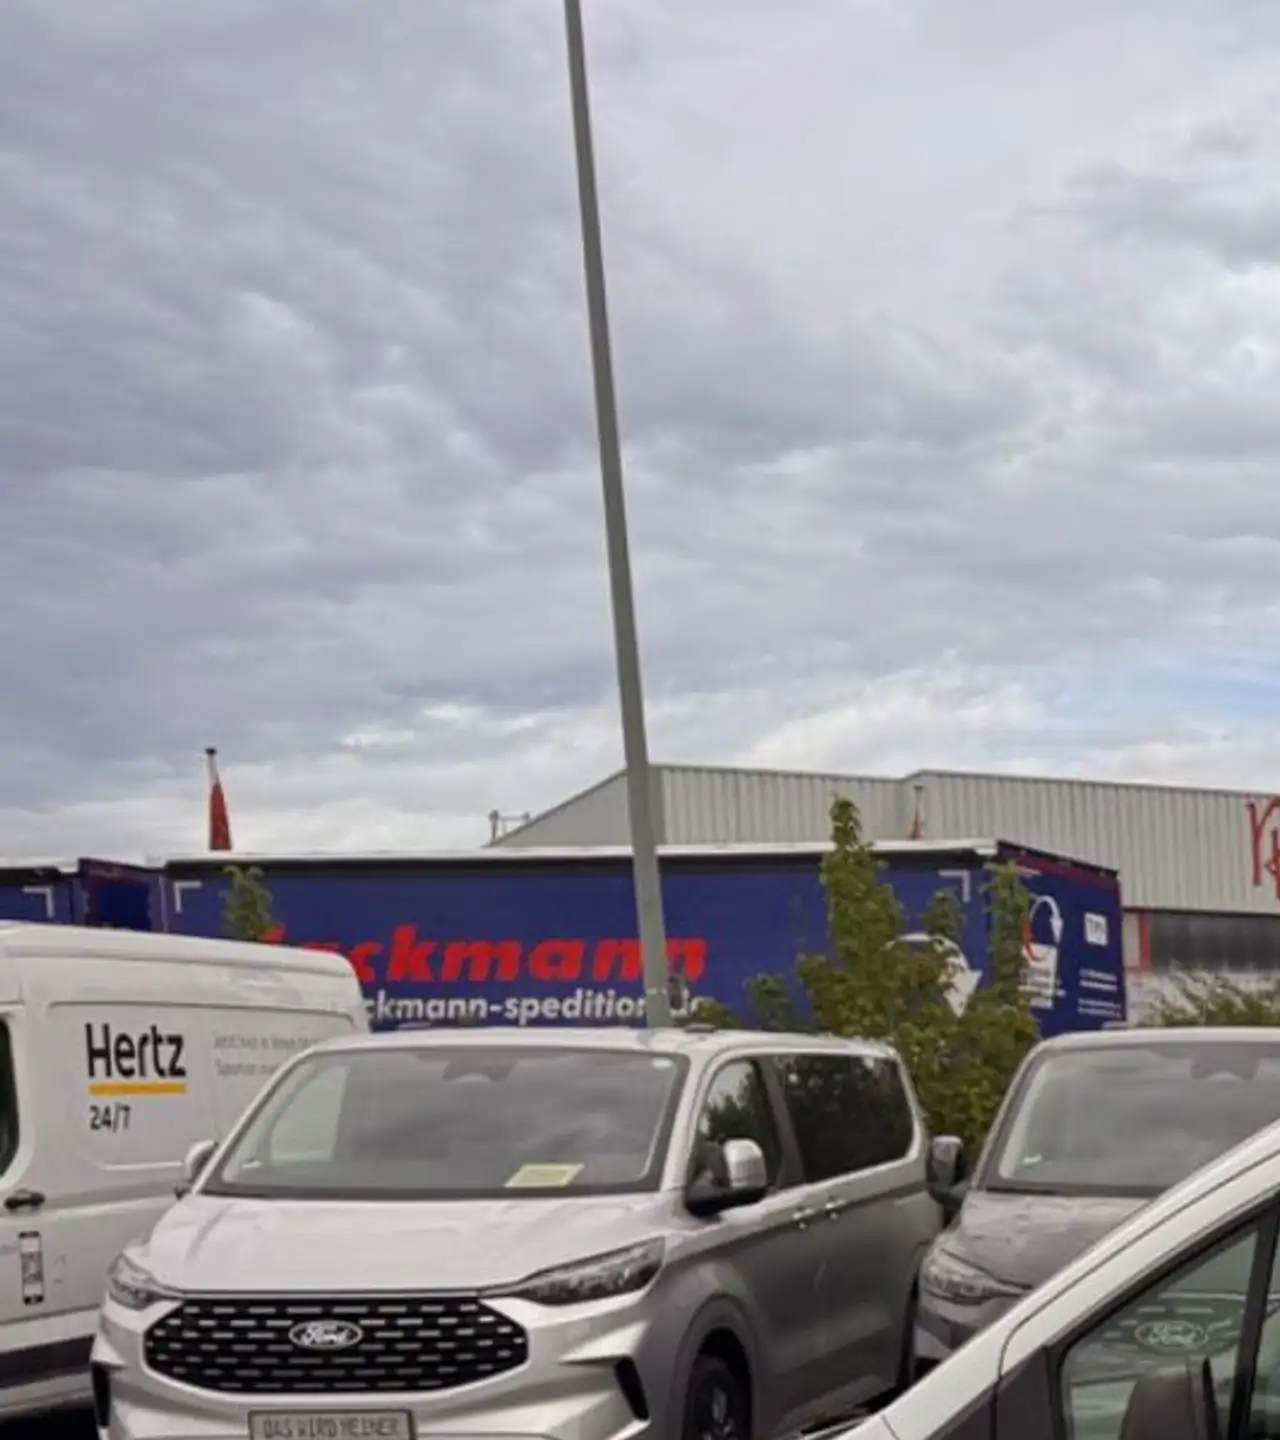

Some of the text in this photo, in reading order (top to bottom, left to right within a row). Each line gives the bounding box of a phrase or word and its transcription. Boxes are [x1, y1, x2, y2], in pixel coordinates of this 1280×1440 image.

[258, 922, 708, 984] ckmann
[85, 1022, 187, 1078] Hertz
[90, 1105, 131, 1132] 24/7
